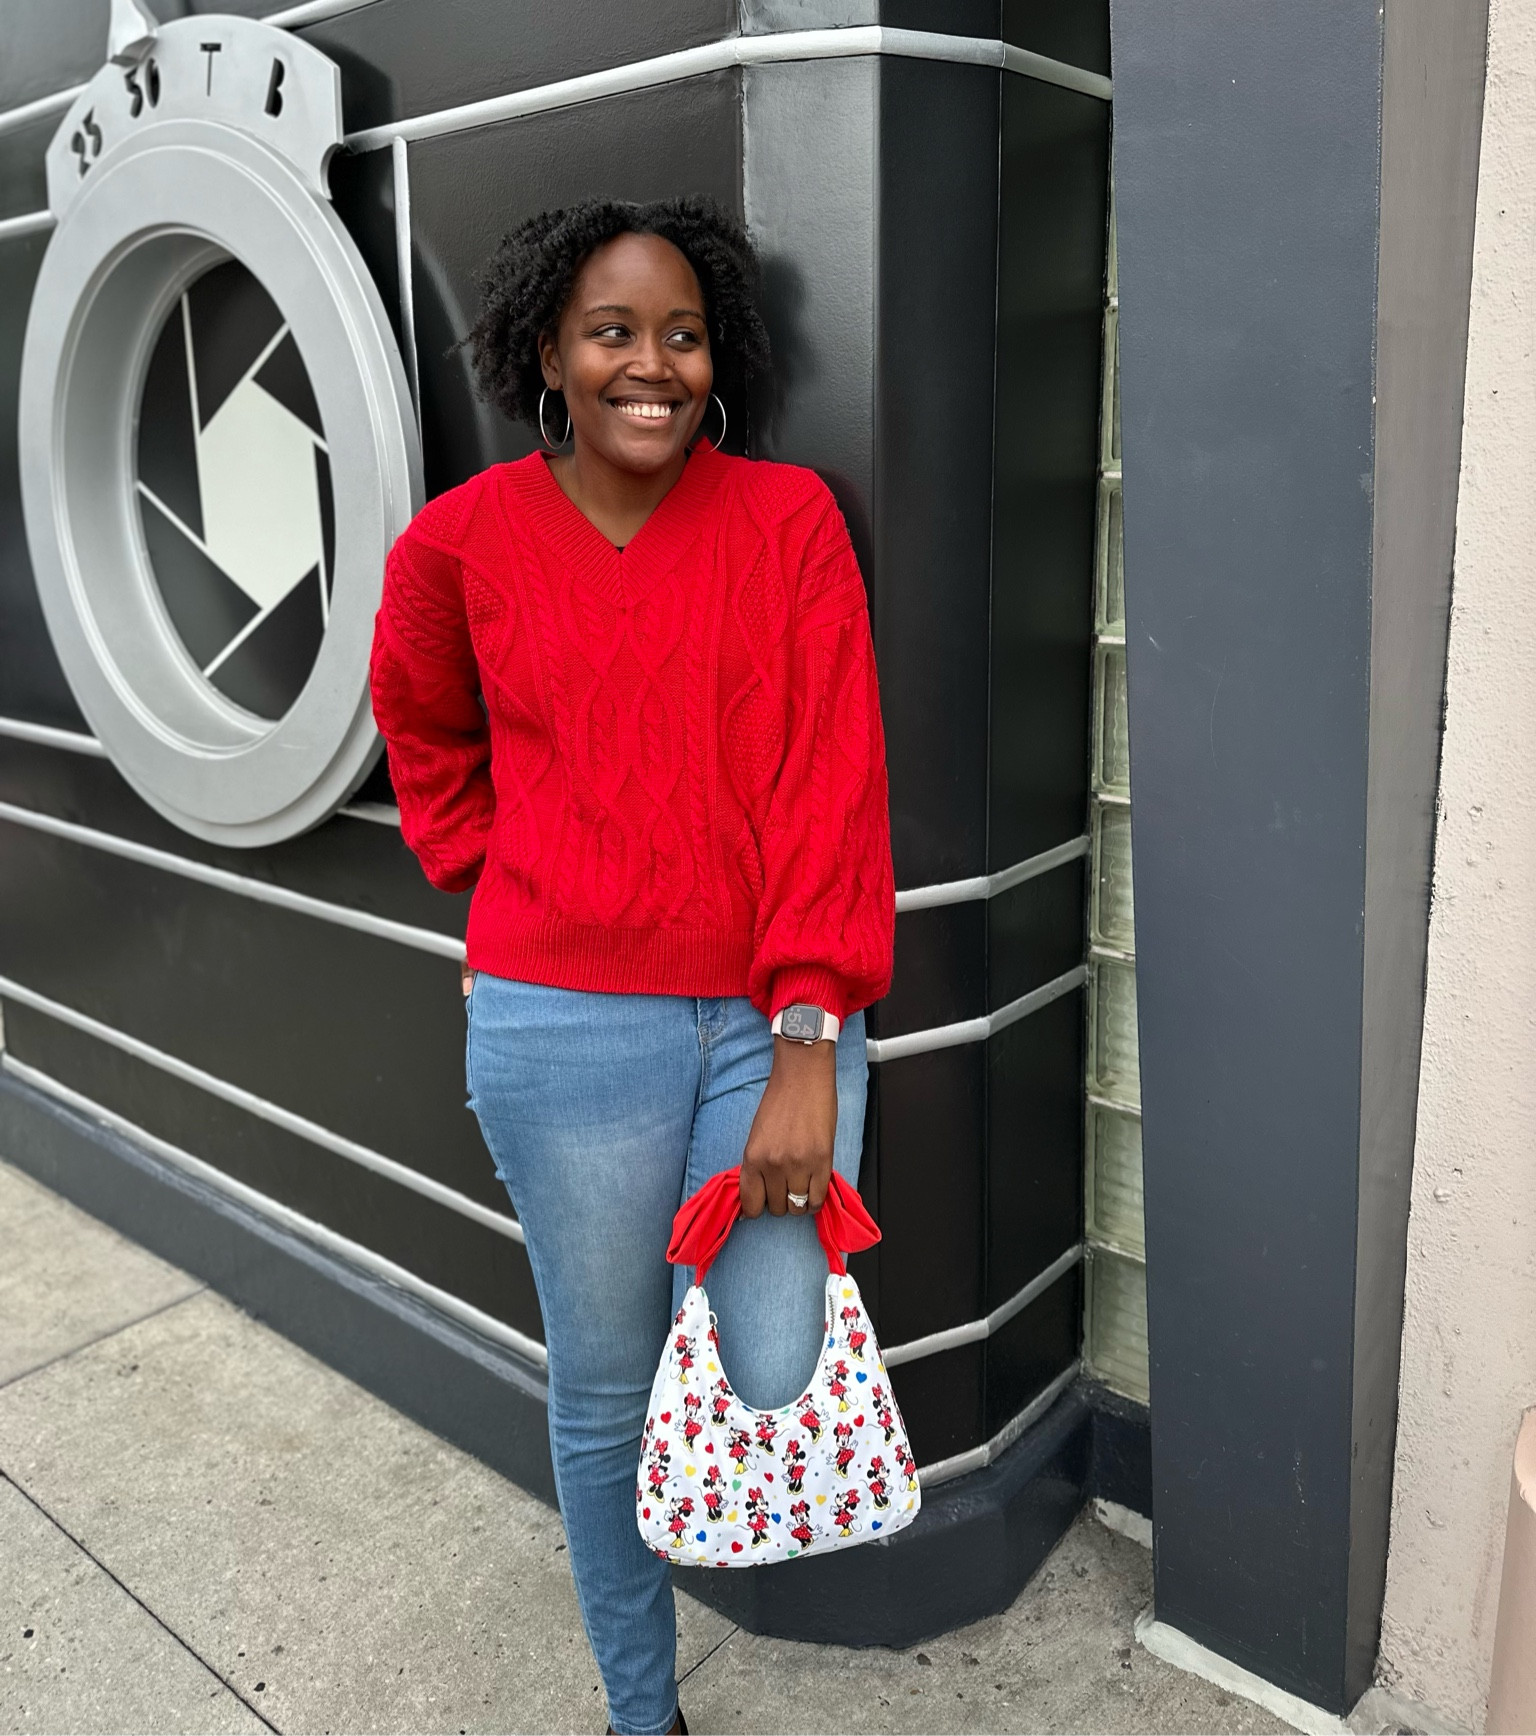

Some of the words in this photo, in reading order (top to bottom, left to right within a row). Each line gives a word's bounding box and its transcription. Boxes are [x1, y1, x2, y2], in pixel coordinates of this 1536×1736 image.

[72, 107, 102, 178] 25
[124, 58, 160, 118] 50
[200, 42, 222, 97] T
[264, 57, 285, 118] B
